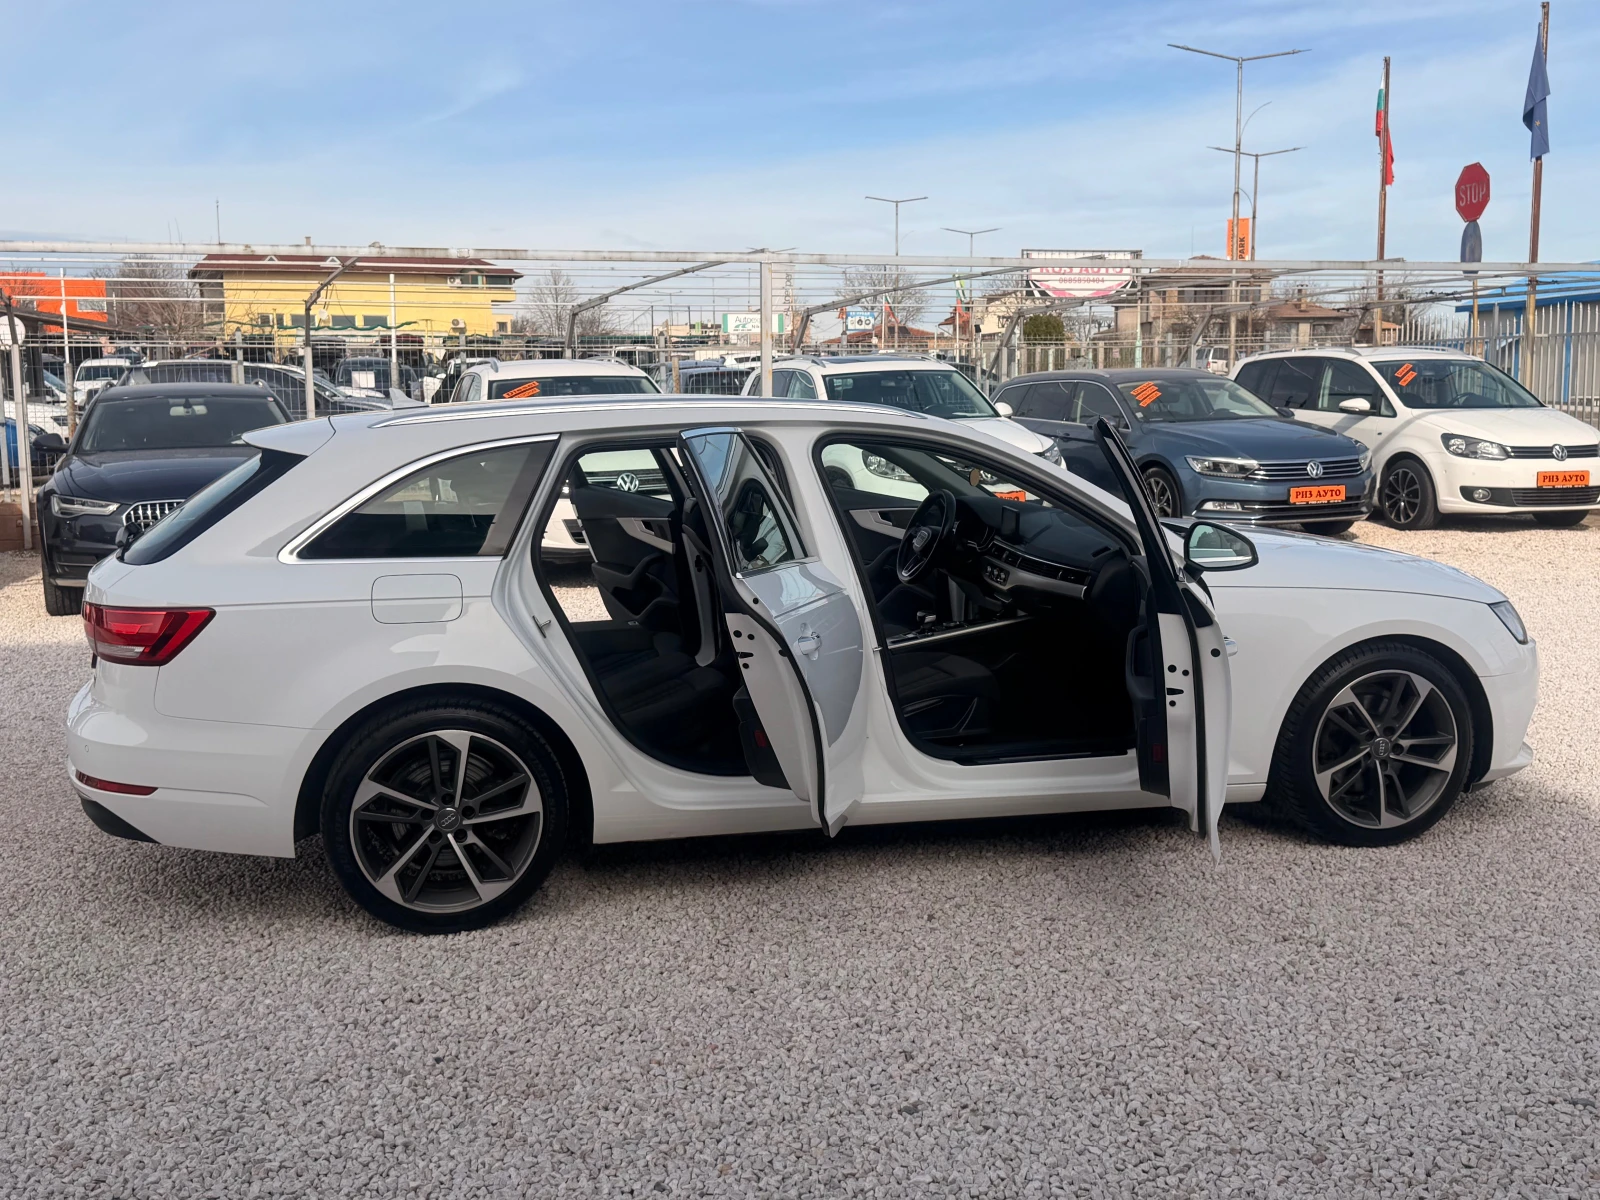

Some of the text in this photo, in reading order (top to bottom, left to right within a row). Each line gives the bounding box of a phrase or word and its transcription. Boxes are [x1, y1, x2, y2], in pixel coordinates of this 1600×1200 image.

[1459, 182, 1486, 207] STOP
[1238, 236, 1246, 260] PARK
[334, 811, 353, 873] DUNLOP
